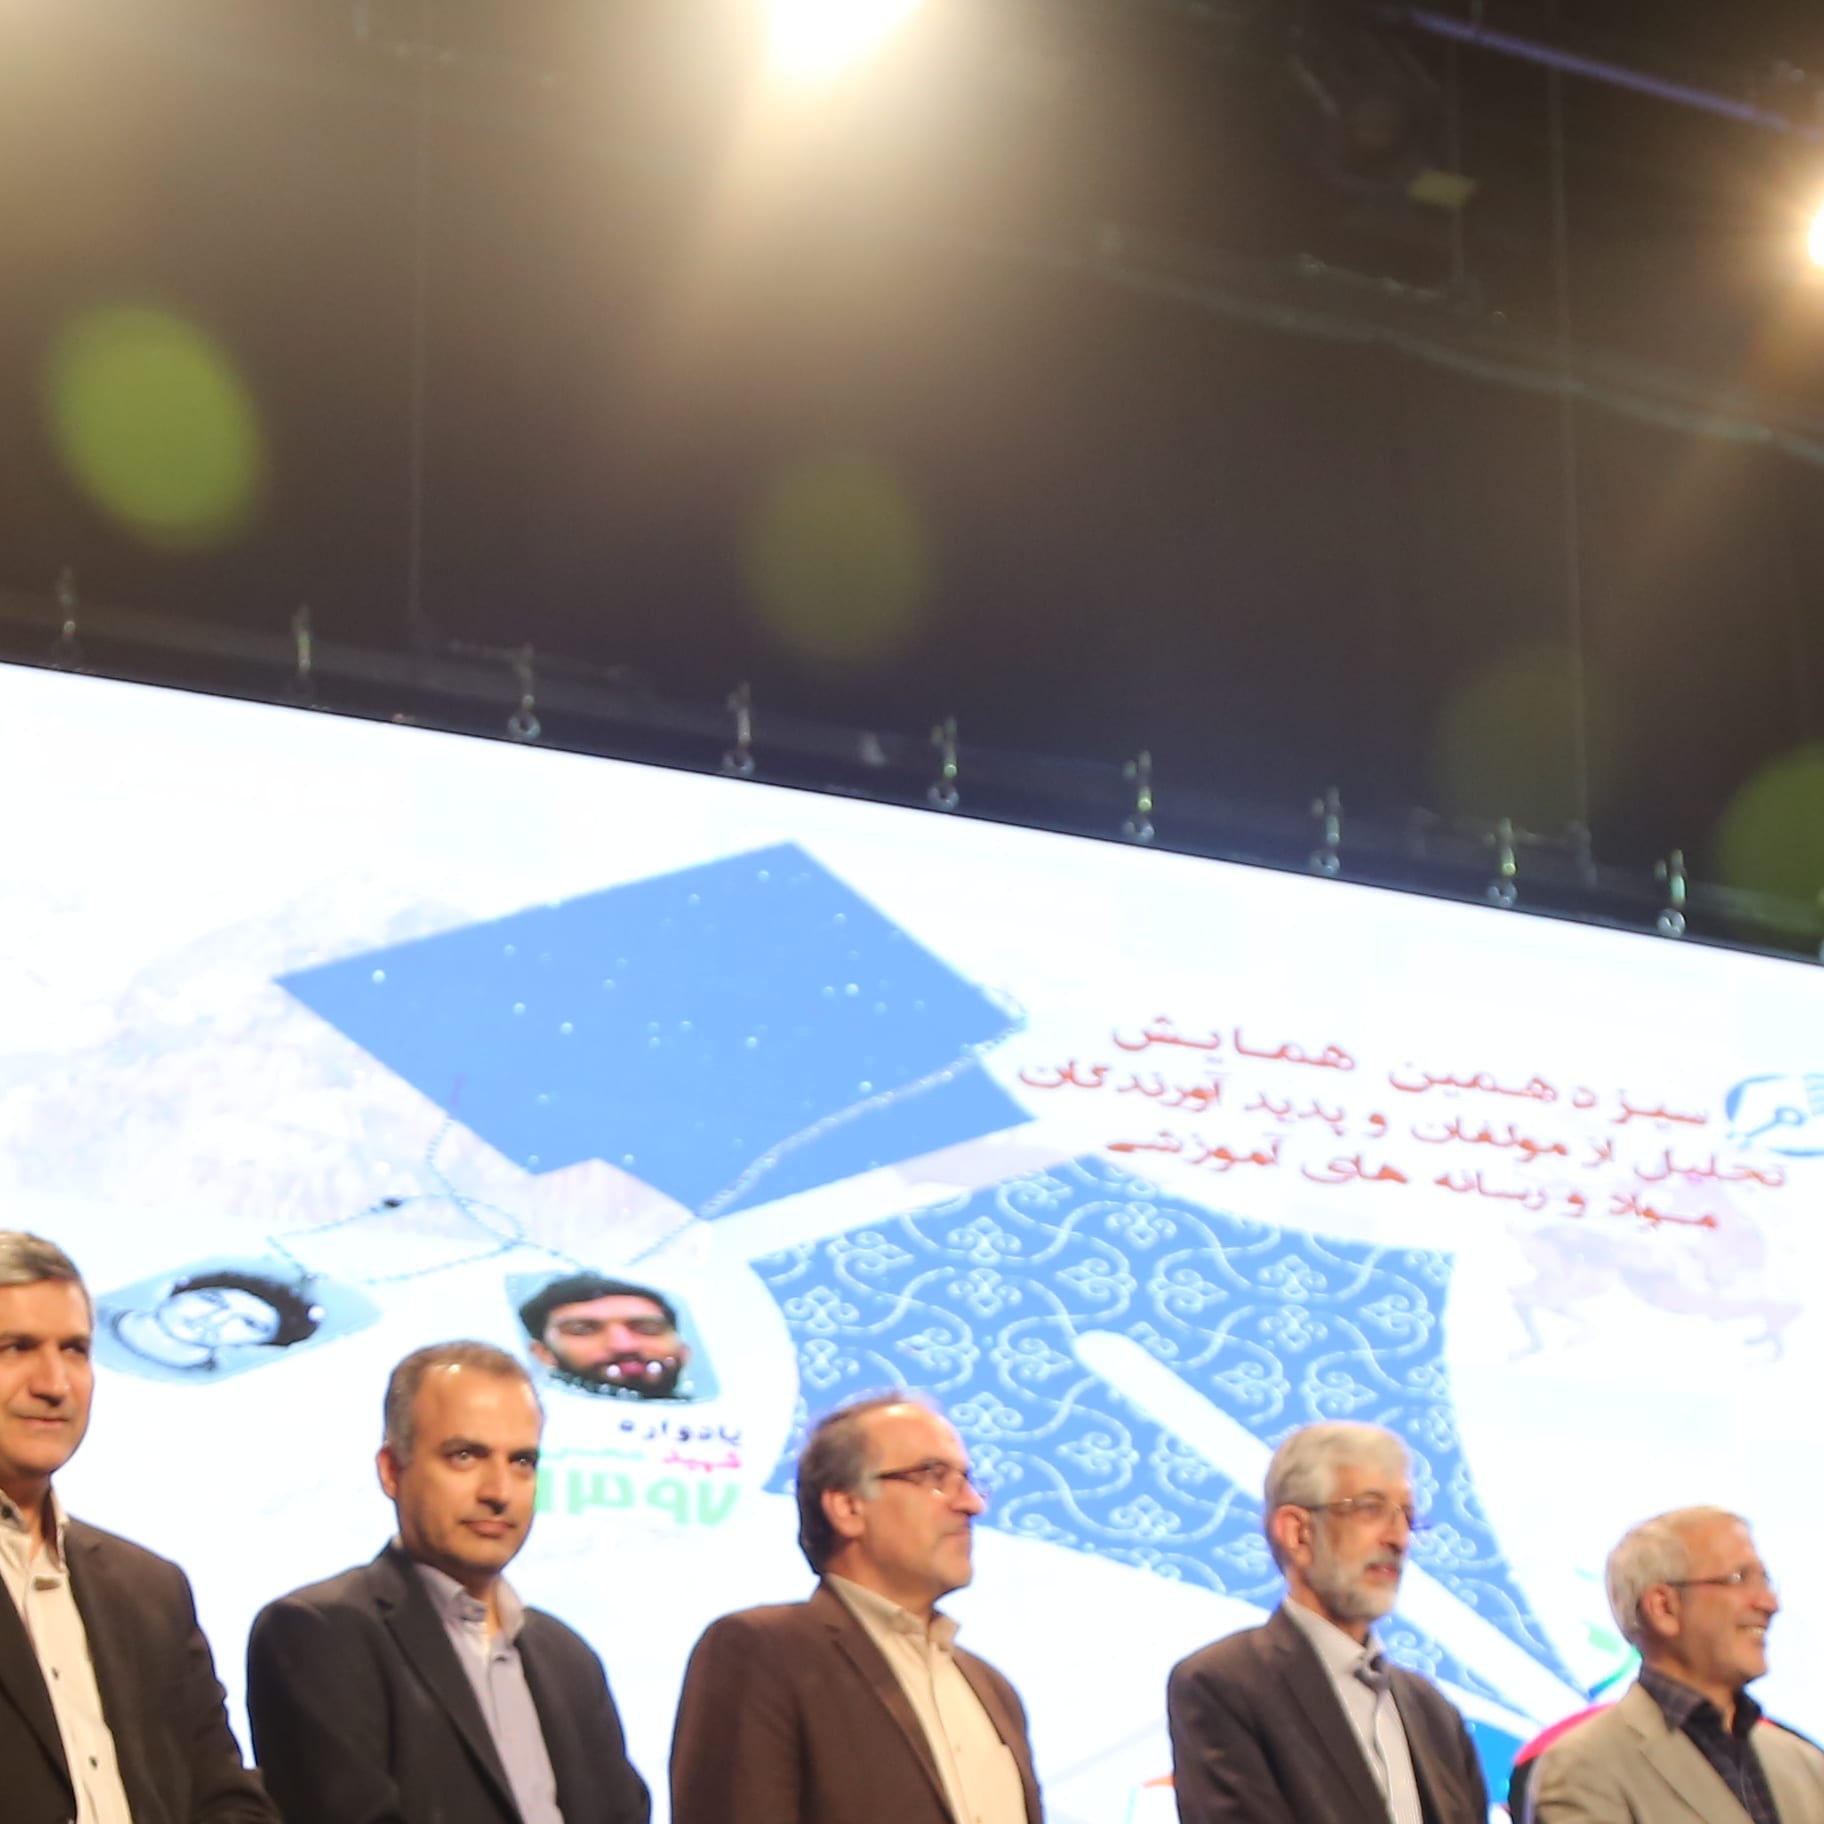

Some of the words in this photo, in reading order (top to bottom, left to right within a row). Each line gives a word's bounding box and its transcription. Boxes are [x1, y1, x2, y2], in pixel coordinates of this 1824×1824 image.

[1111, 1015, 1356, 1071] همایش
[1388, 1060, 1708, 1129] سیزدهمین
[1364, 1113, 1388, 1138] و
[1300, 1155, 1409, 1185] های
[1580, 1137, 1614, 1168] از
[1632, 1147, 1785, 1187] تجلیل
[1433, 1170, 1547, 1212] رسانه
[1564, 1192, 1587, 1219] و
[1608, 1193, 1718, 1231] مواد
